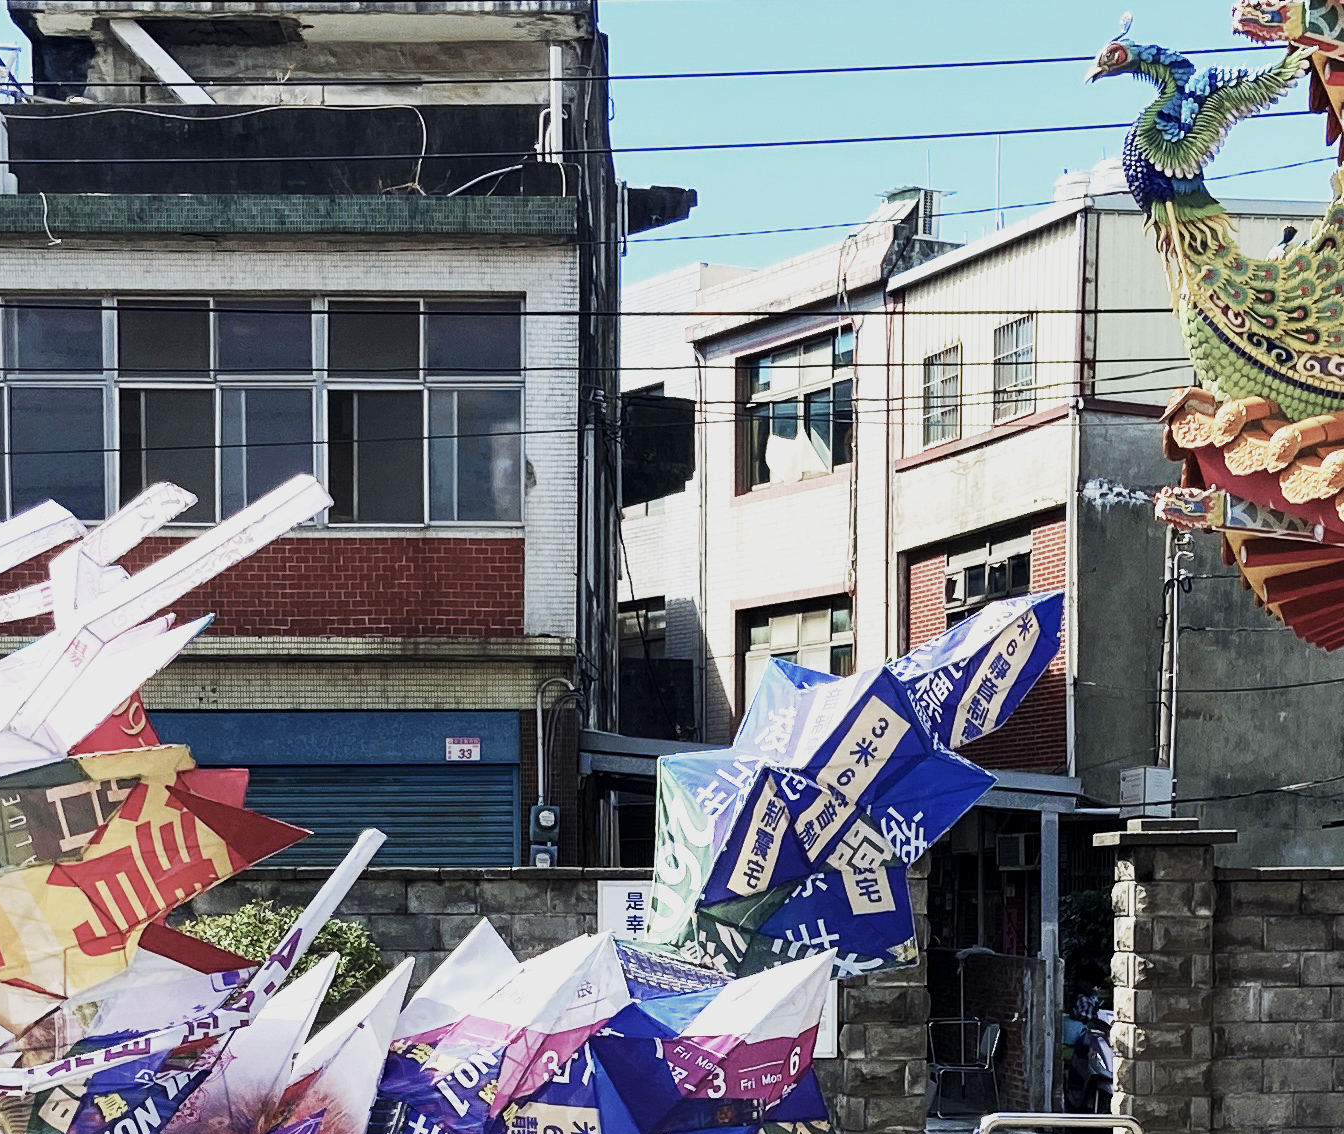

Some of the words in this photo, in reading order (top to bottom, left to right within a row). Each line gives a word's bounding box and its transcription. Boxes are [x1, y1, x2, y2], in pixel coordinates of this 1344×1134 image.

[458, 748, 473, 760] 33
[625, 891, 645, 940] 是幸
[435, 1047, 498, 1117] NO.1
